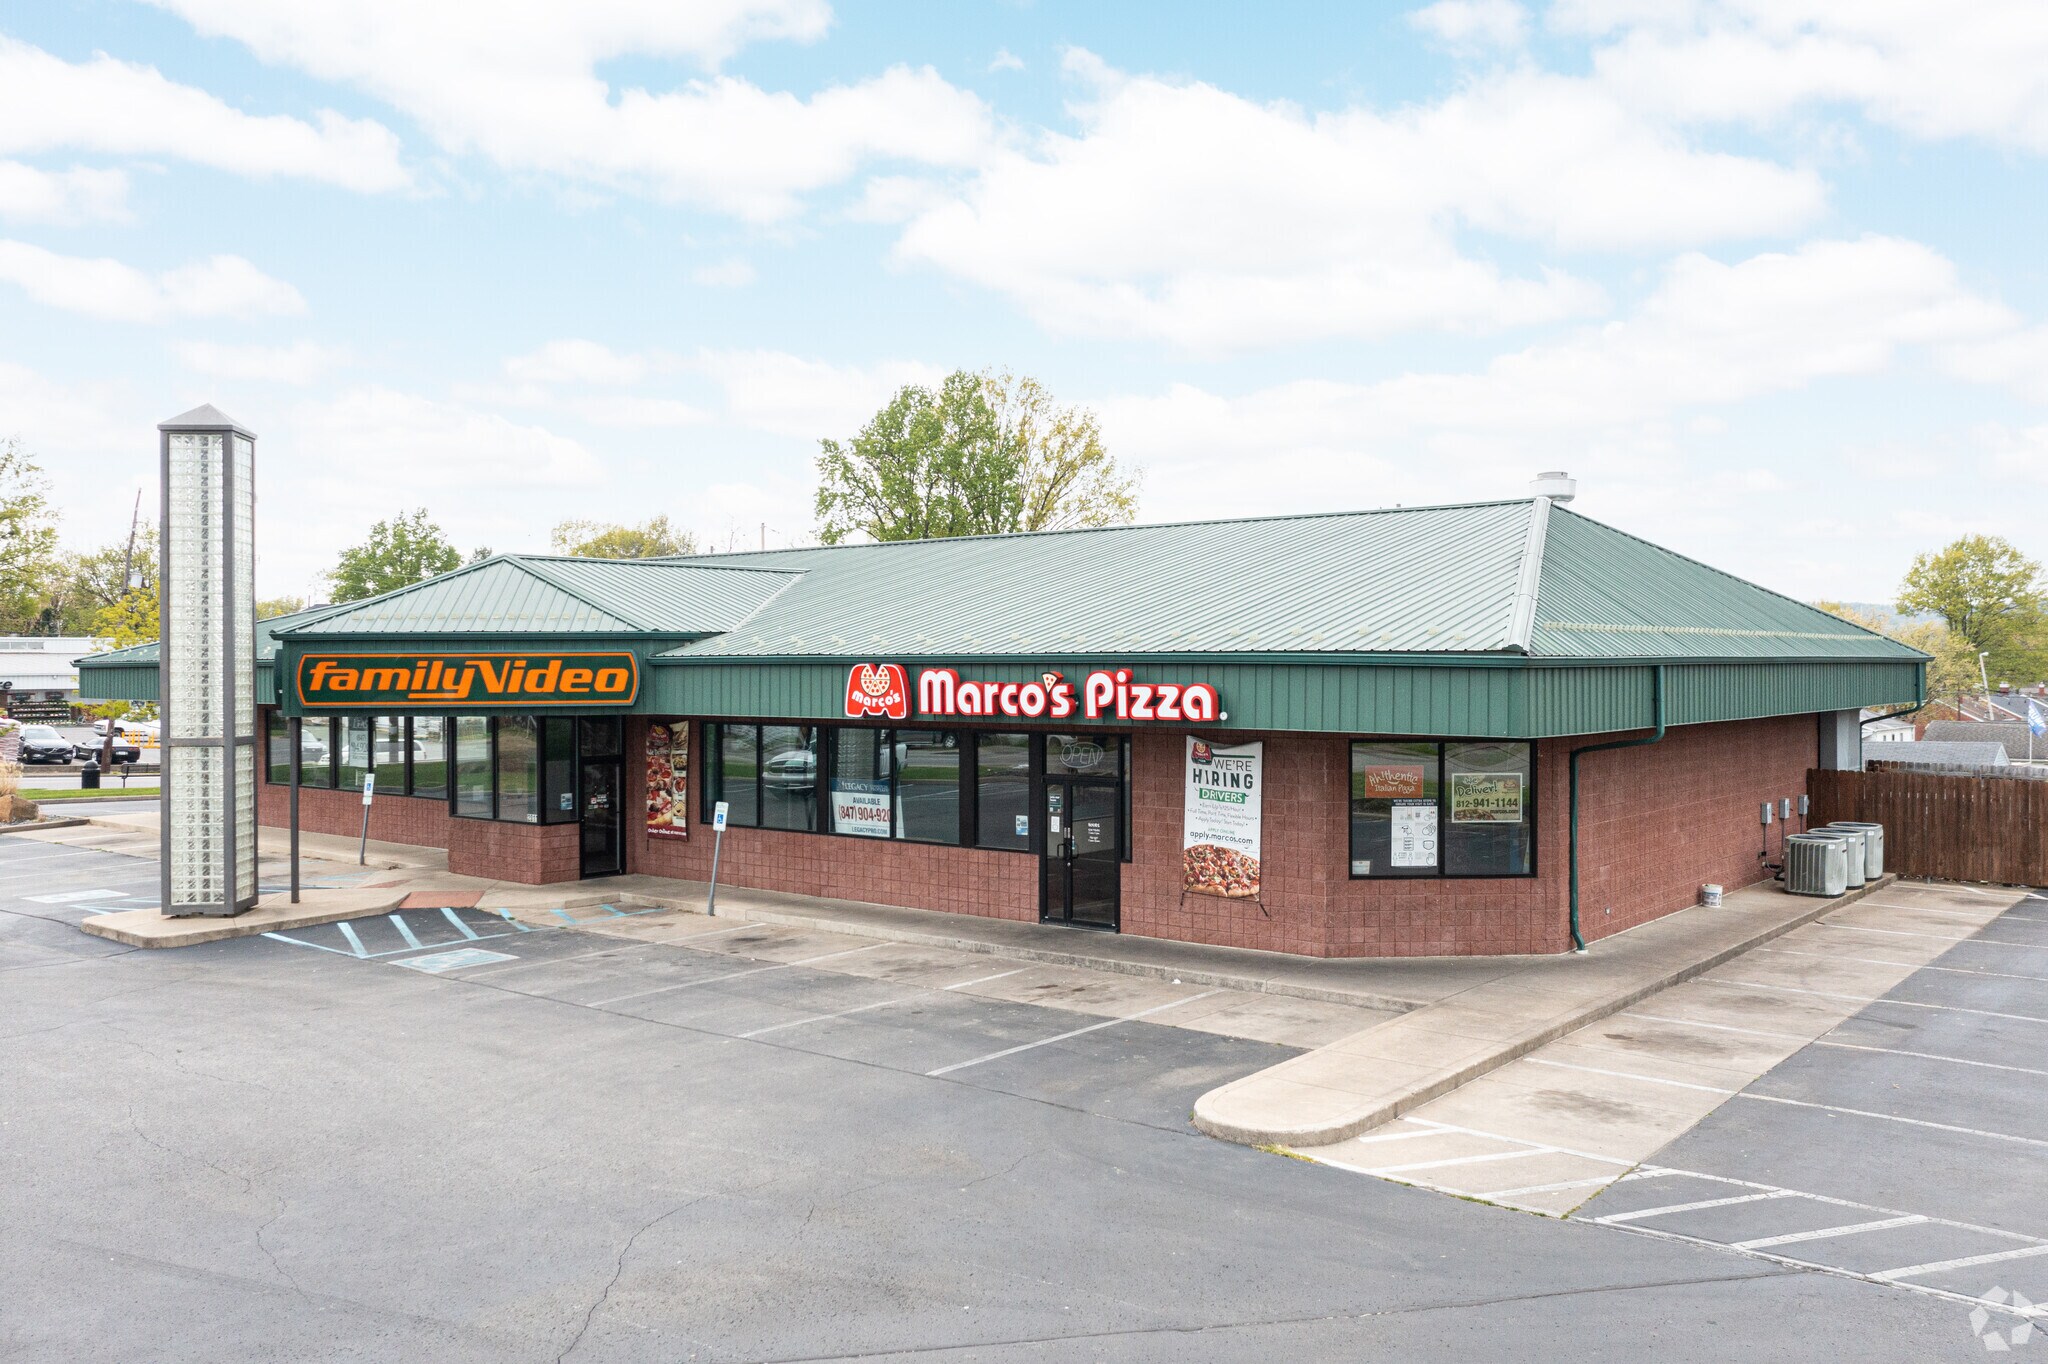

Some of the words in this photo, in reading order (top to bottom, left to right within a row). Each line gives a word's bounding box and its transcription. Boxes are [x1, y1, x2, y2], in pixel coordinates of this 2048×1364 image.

[919, 668, 1075, 717] Marco's
[1085, 668, 1219, 721] Pizza
[1061, 744, 1101, 765] OPEN
[1214, 758, 1252, 772] WE'RE
[1193, 768, 1253, 789] HIRING
[844, 782, 868, 791] LEGACY
[1375, 784, 1396, 792] Italian
[1457, 781, 1498, 797] Deliver!
[853, 797, 881, 805] AVAILABLE
[1202, 789, 1243, 803] DRIVERS
[1456, 797, 1518, 808] 812-941-1144
[1190, 831, 1253, 844] apply.marcos.com
